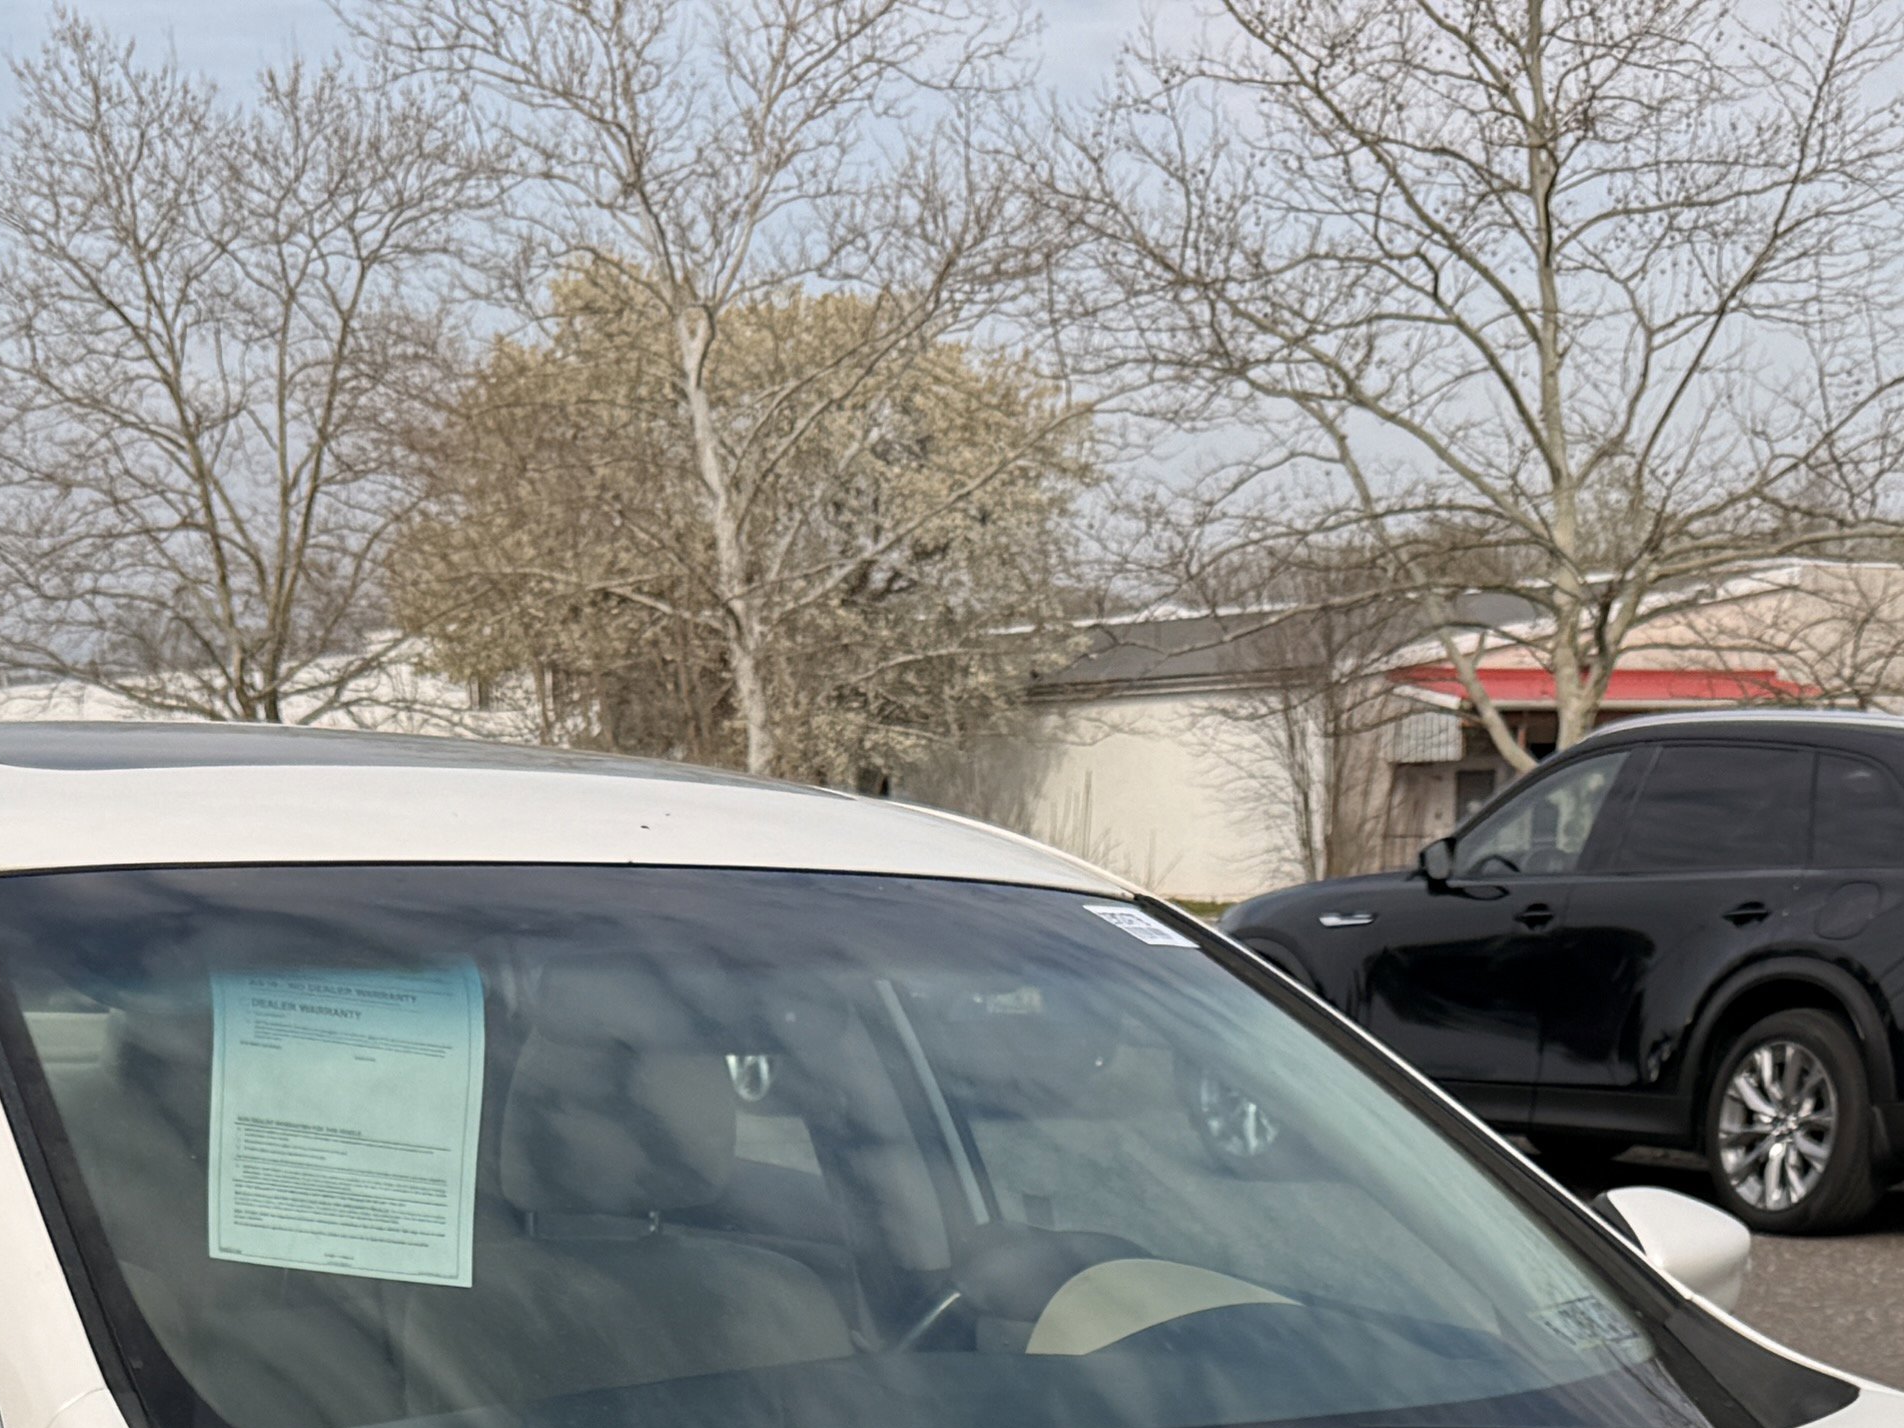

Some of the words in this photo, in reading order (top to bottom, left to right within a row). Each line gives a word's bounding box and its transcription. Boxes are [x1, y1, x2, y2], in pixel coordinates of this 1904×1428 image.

[307, 983, 352, 995] DEALER
[355, 988, 417, 1003] WARRANTY
[251, 998, 297, 1011] DEALER
[299, 1004, 362, 1019] WARRANTY
